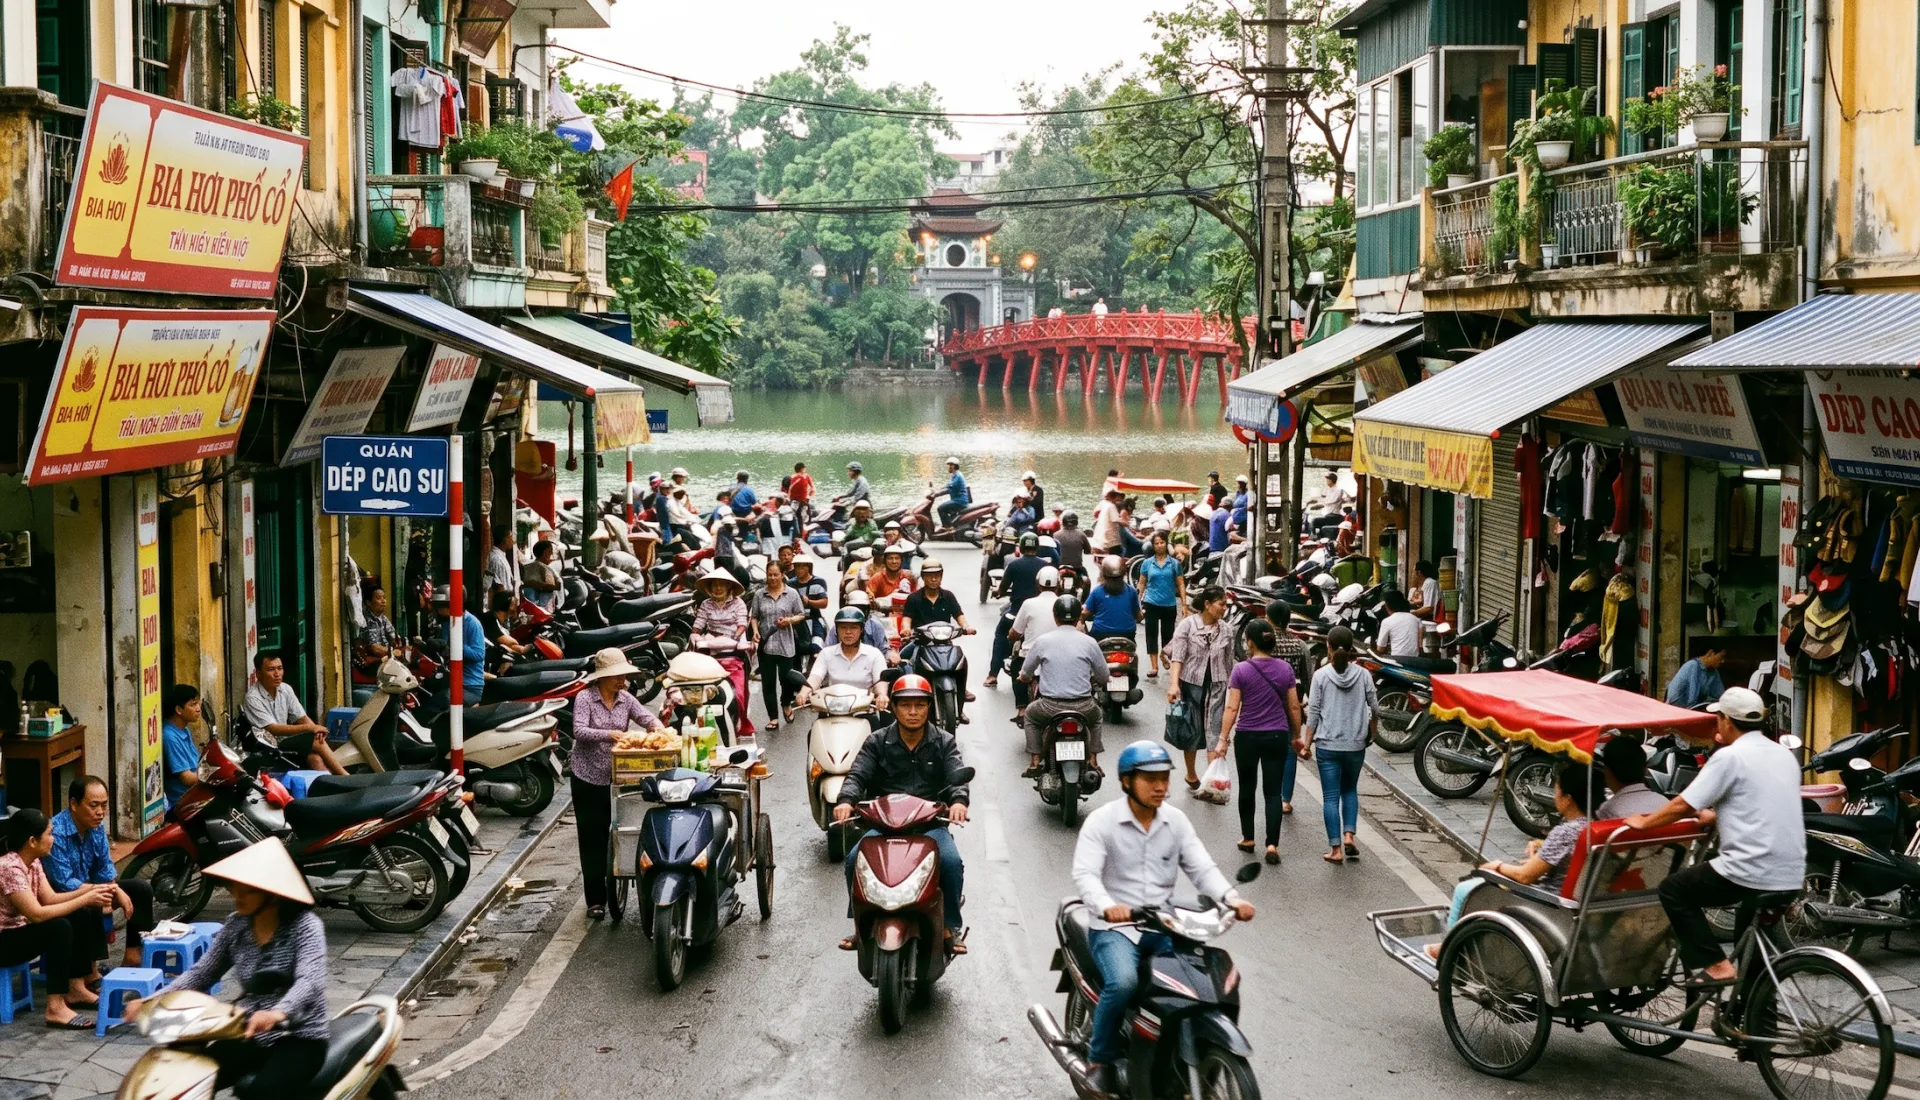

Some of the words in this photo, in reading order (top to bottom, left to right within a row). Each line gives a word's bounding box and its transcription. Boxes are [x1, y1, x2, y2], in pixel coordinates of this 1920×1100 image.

[86, 196, 104, 219] BIA
[147, 163, 183, 210] BIA
[185, 171, 225, 216] HƠI
[222, 167, 268, 222] PHỐ
[262, 168, 292, 225] CỔ
[109, 362, 142, 402] BIA
[140, 358, 176, 399] HƠI
[1819, 383, 1866, 435] DÉP
[360, 442, 414, 459] QUÁN
[327, 461, 366, 492] DÉP
[372, 468, 412, 493] CAO
[417, 468, 444, 494] SU
[142, 566, 156, 597] BIA
